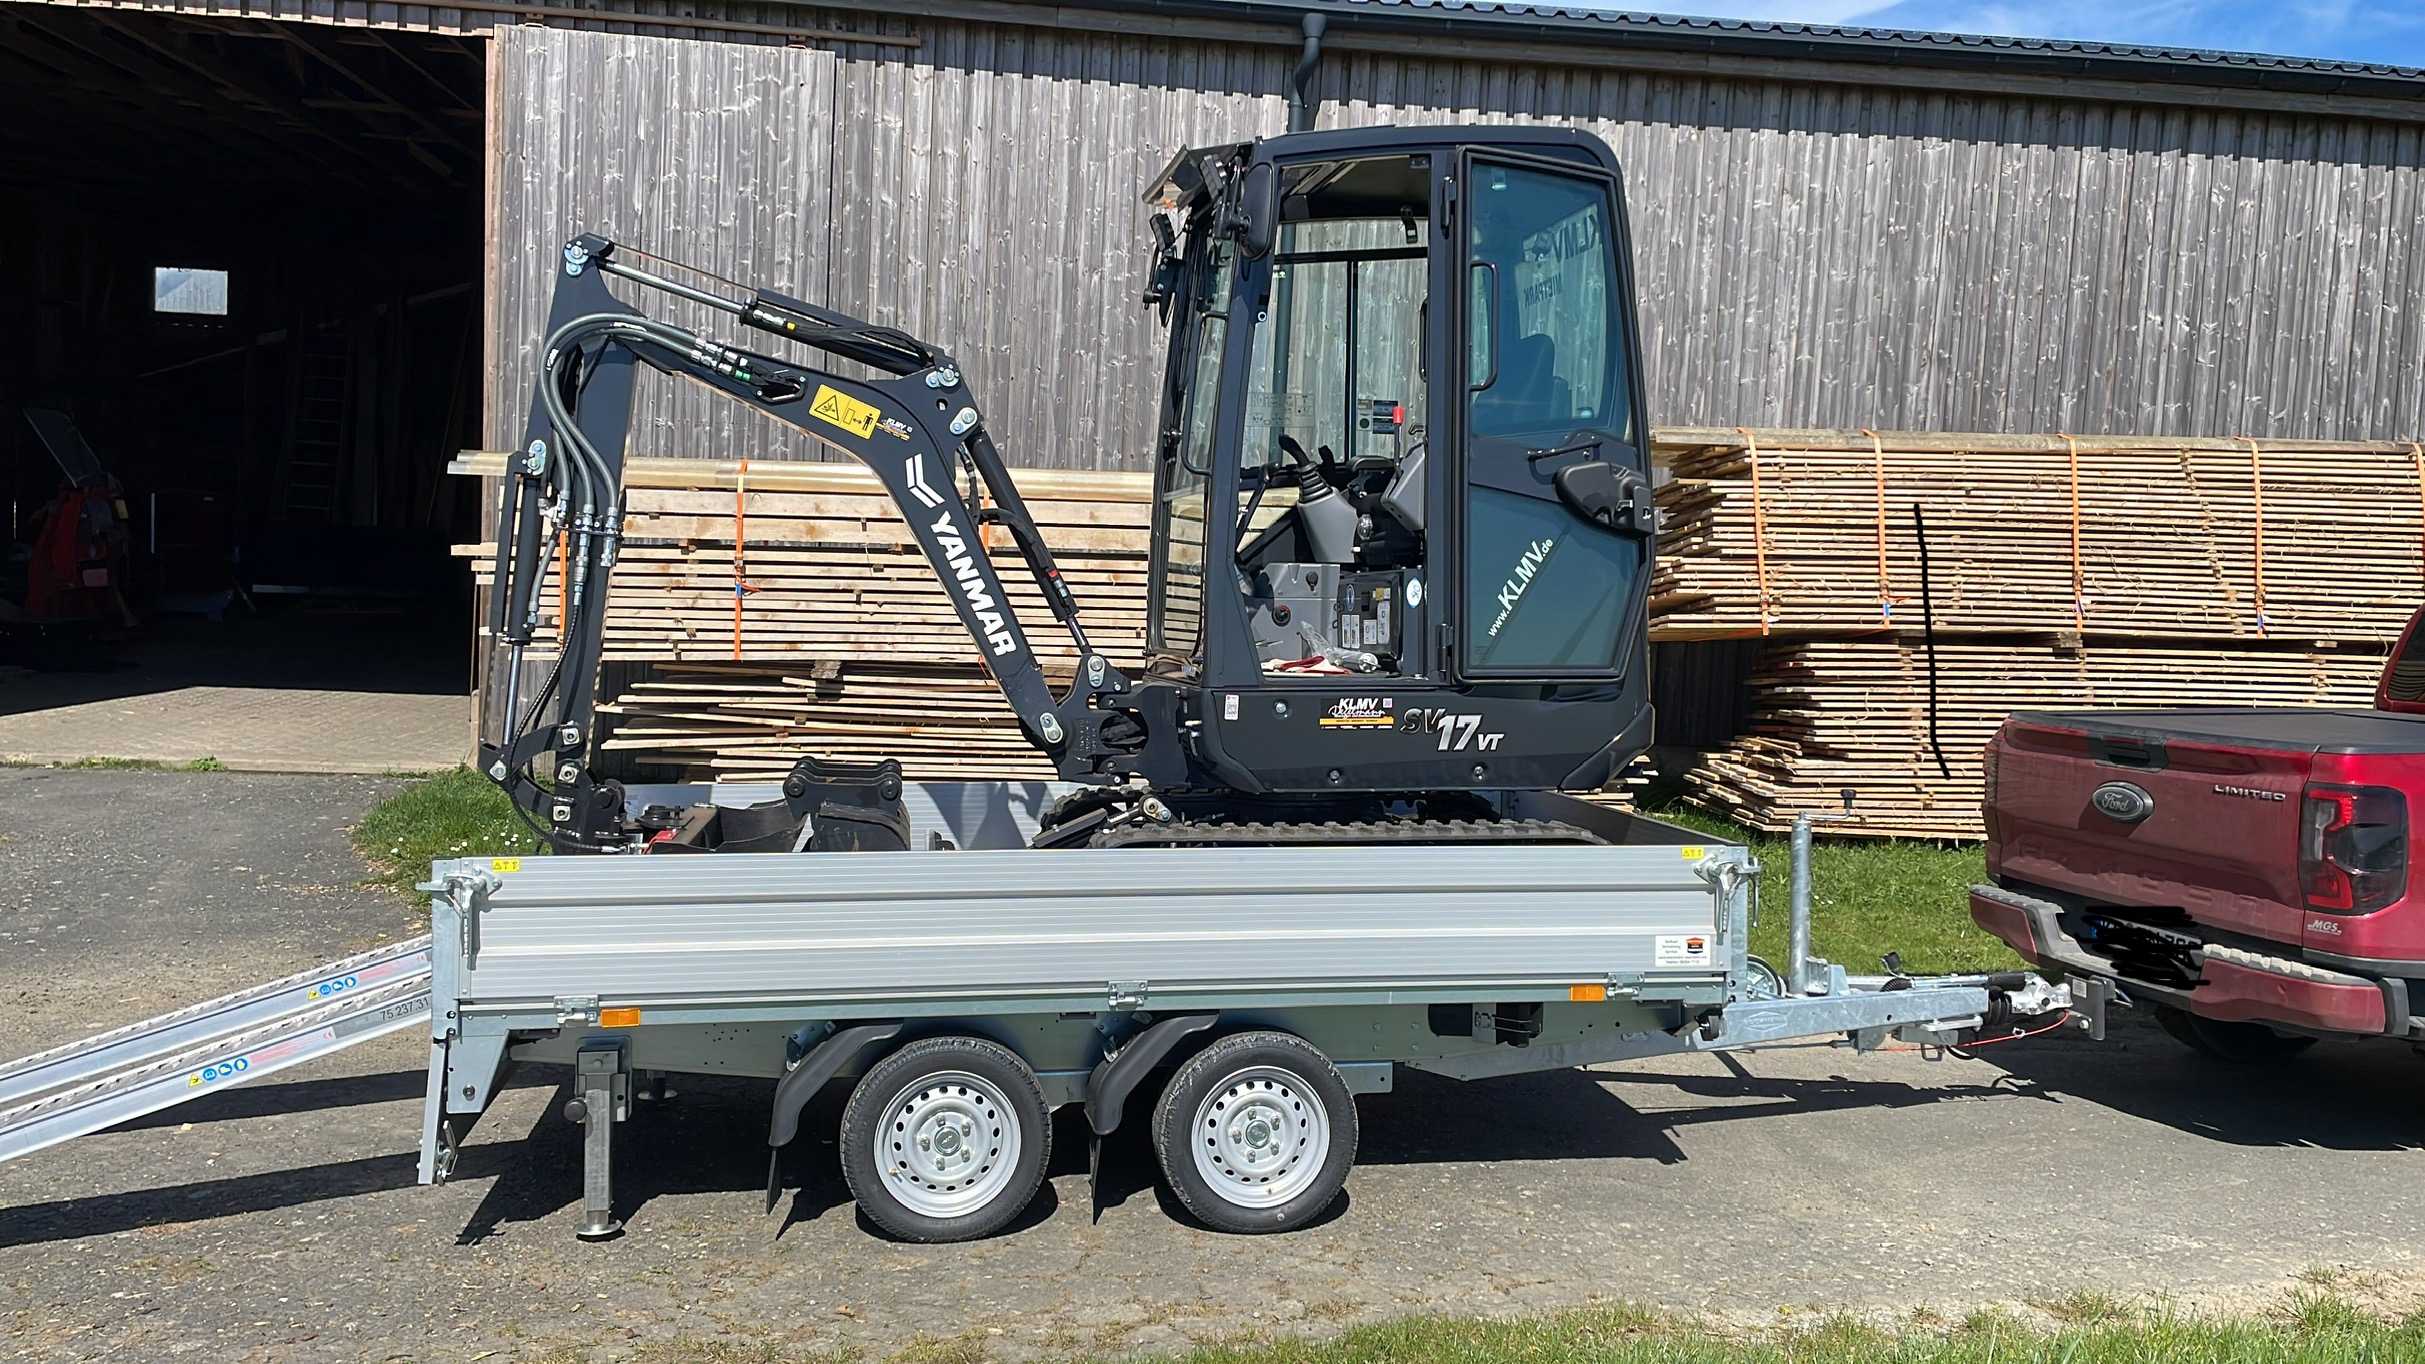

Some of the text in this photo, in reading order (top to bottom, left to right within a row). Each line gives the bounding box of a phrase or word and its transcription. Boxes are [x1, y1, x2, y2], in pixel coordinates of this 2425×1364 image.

[930, 510, 1017, 657] YANMAR
[1487, 538, 1554, 637] www.KLMV.de
[1339, 697, 1379, 709] KLMV
[2101, 791, 2130, 812] Ford
[2213, 783, 2287, 802] LIMITED
[2312, 918, 2340, 932] MGS
[379, 997, 430, 1021] 75.237.31
